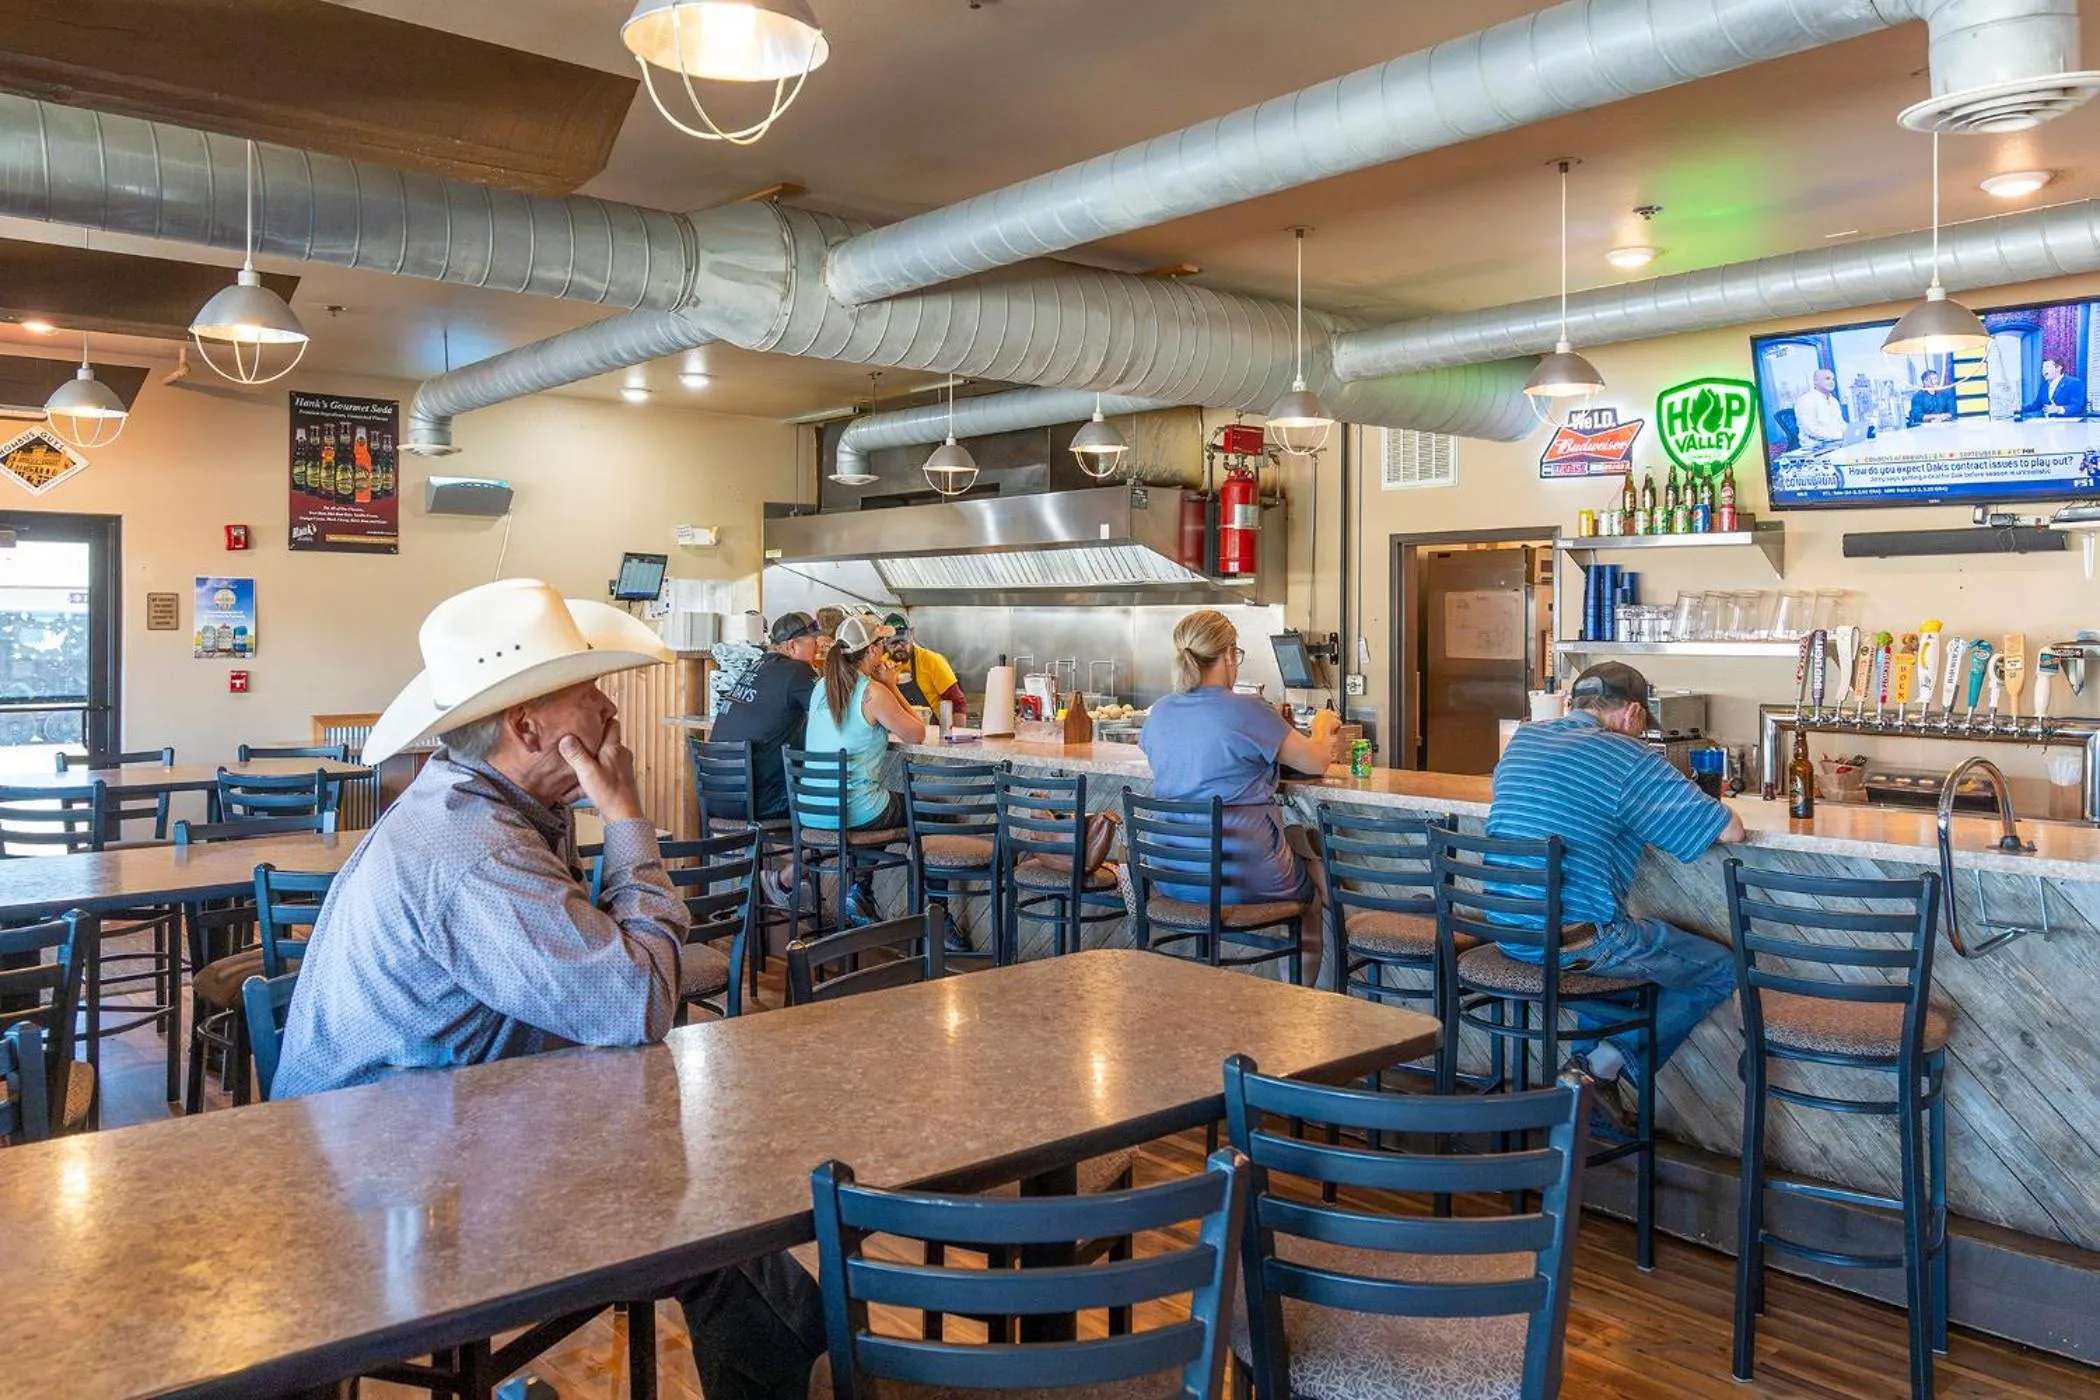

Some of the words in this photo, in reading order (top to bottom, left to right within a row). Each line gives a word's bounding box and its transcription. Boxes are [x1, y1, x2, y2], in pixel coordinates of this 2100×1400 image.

[295, 397, 328, 409] Hank's
[329, 400, 370, 413] Gourmet
[370, 404, 393, 415] Soda
[40, 431, 65, 450] GUYS
[1555, 437, 1629, 455] Budweiser
[1675, 431, 1737, 453] VALLEY
[1848, 465, 1867, 475] How
[1868, 465, 1879, 475] do
[1880, 466, 1895, 477] you
[1896, 464, 1925, 476] expect
[1926, 462, 1949, 472] Dak's
[1950, 460, 1988, 471] contract
[1989, 459, 2018, 469] issues
[2019, 458, 2028, 467] to
[2030, 457, 2051, 468] play
[2051, 456, 2073, 466] out?
[1814, 639, 1824, 668] LIGHT
[1814, 668, 1823, 690] BUD
